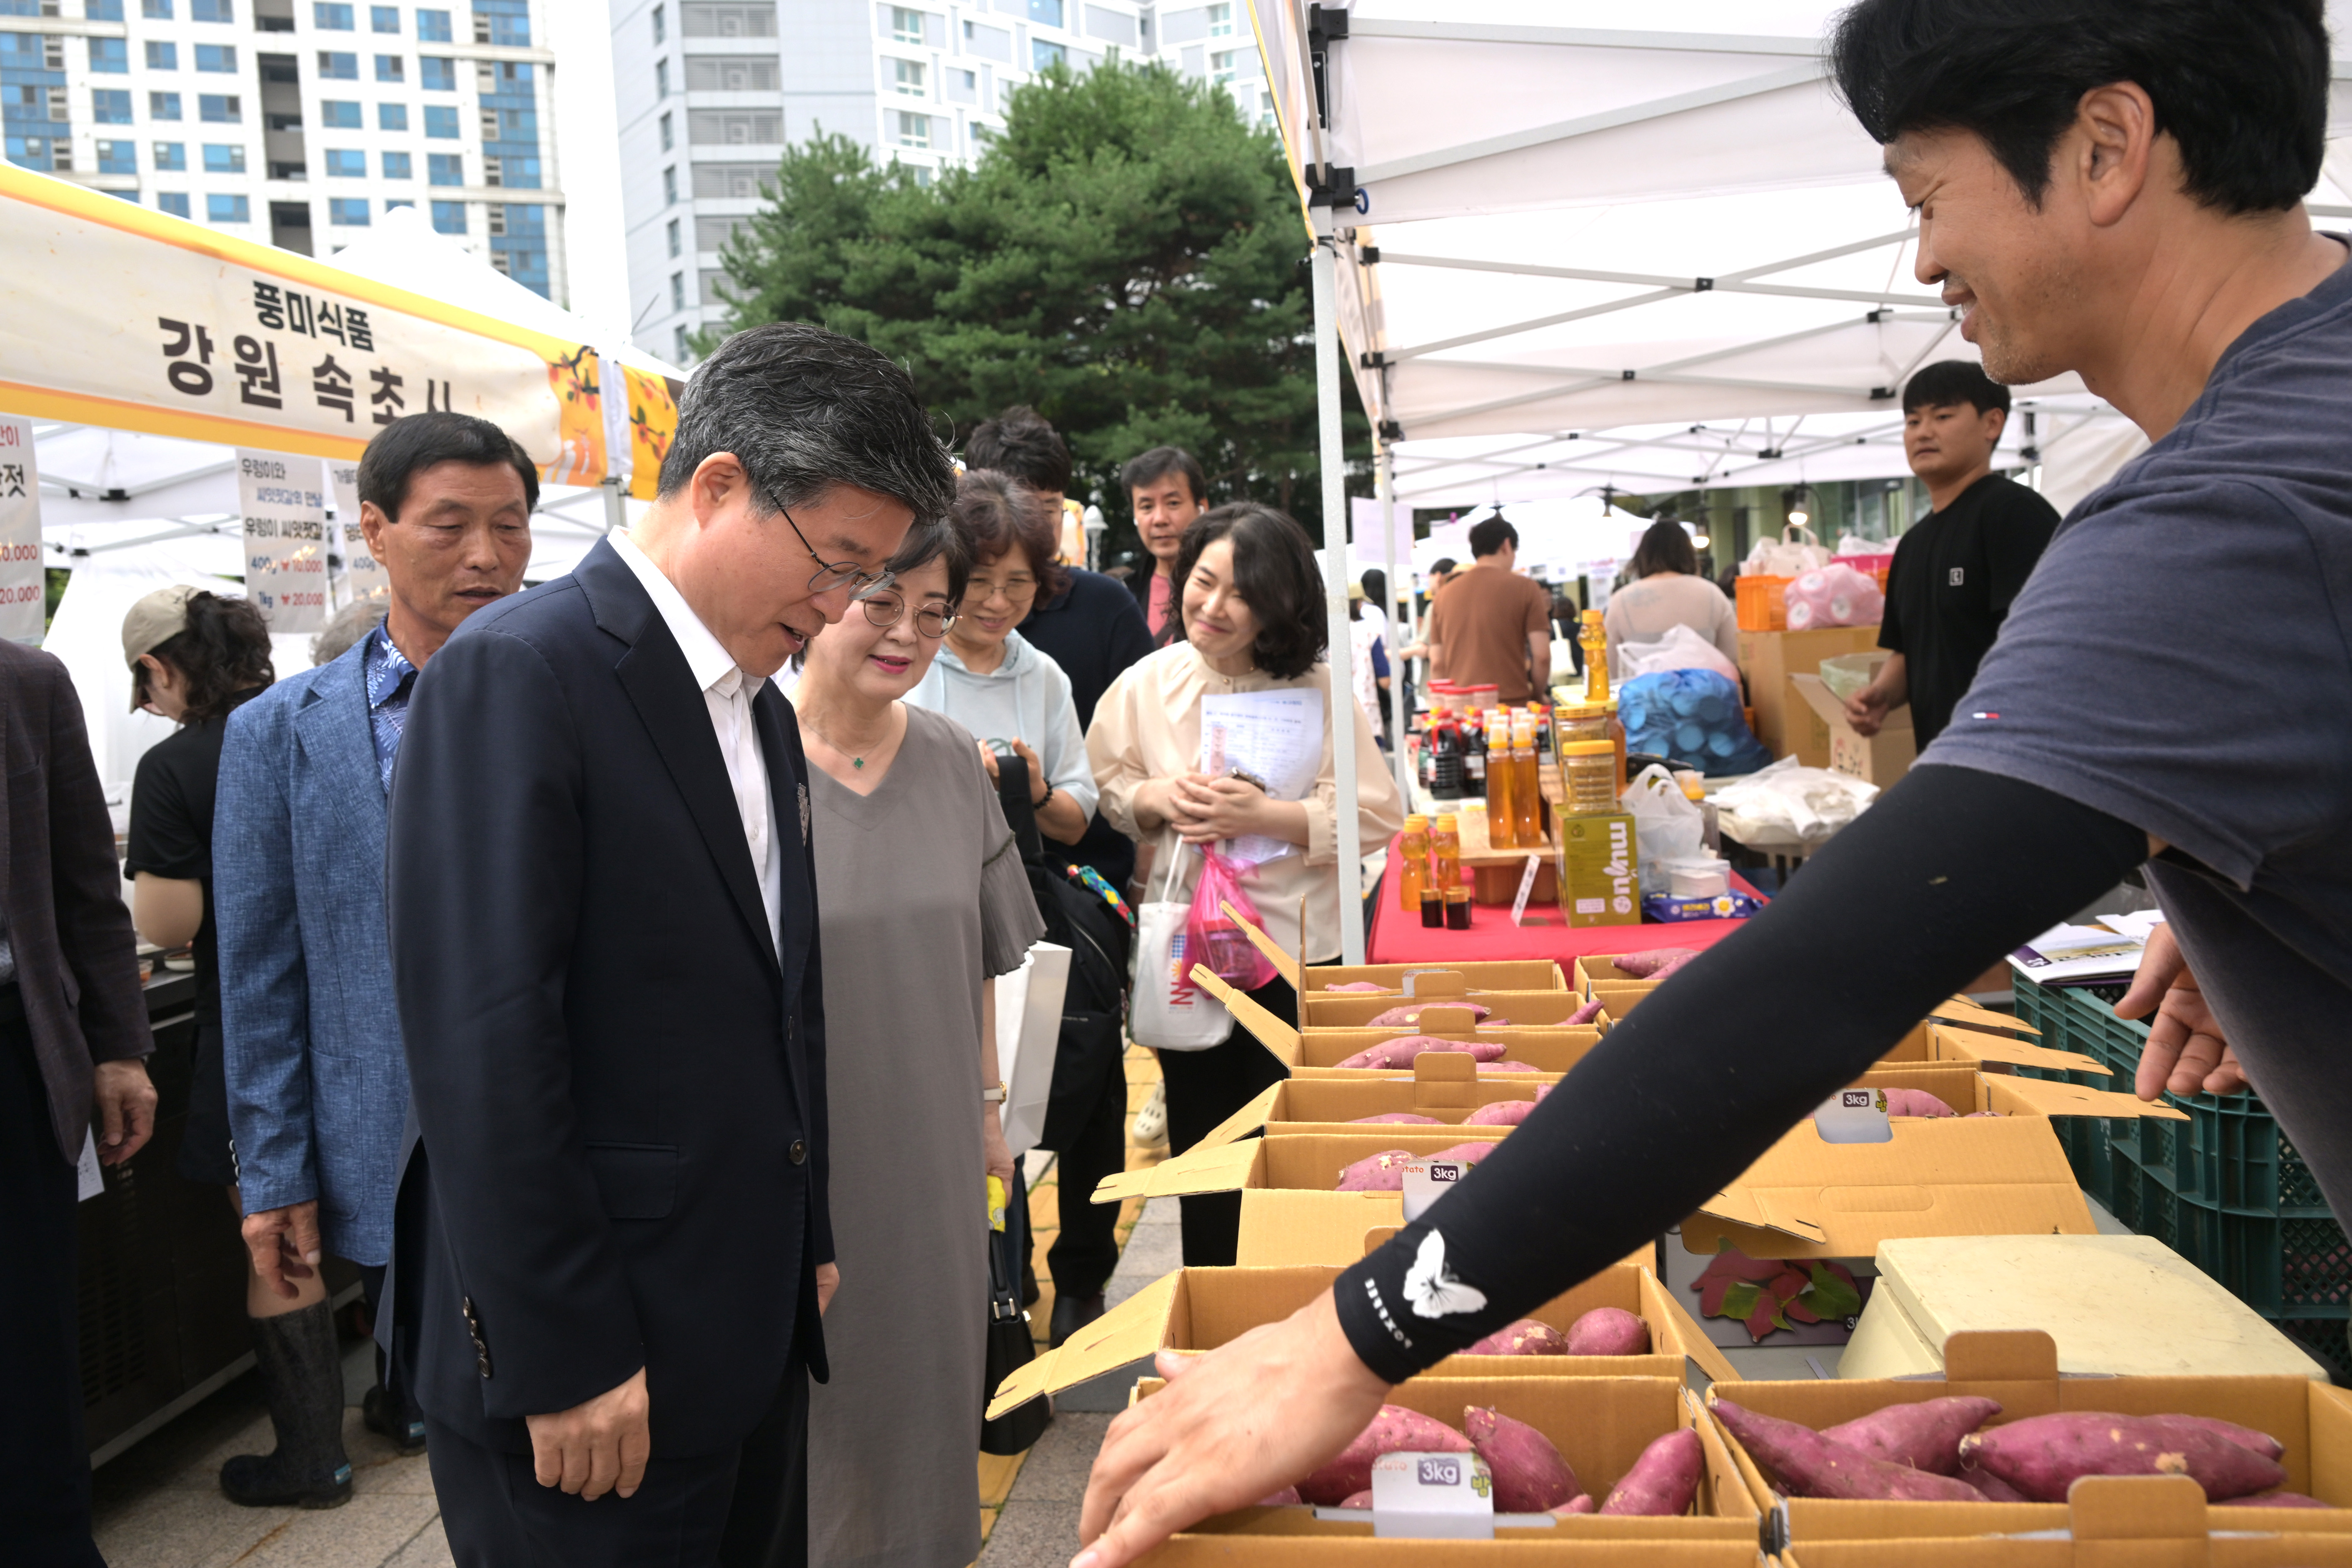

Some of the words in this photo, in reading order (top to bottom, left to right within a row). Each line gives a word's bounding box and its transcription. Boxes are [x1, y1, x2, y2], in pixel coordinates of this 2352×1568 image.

[253, 281, 375, 353] 풍미식품
[158, 317, 283, 410] 강원
[242, 458, 286, 480] 우렁이와
[245, 517, 278, 538] 우렁이
[1845, 1094, 1868, 1106] 3kg
[1433, 1167, 1456, 1181] 3kg
[1422, 1461, 1457, 1484] 3kg
